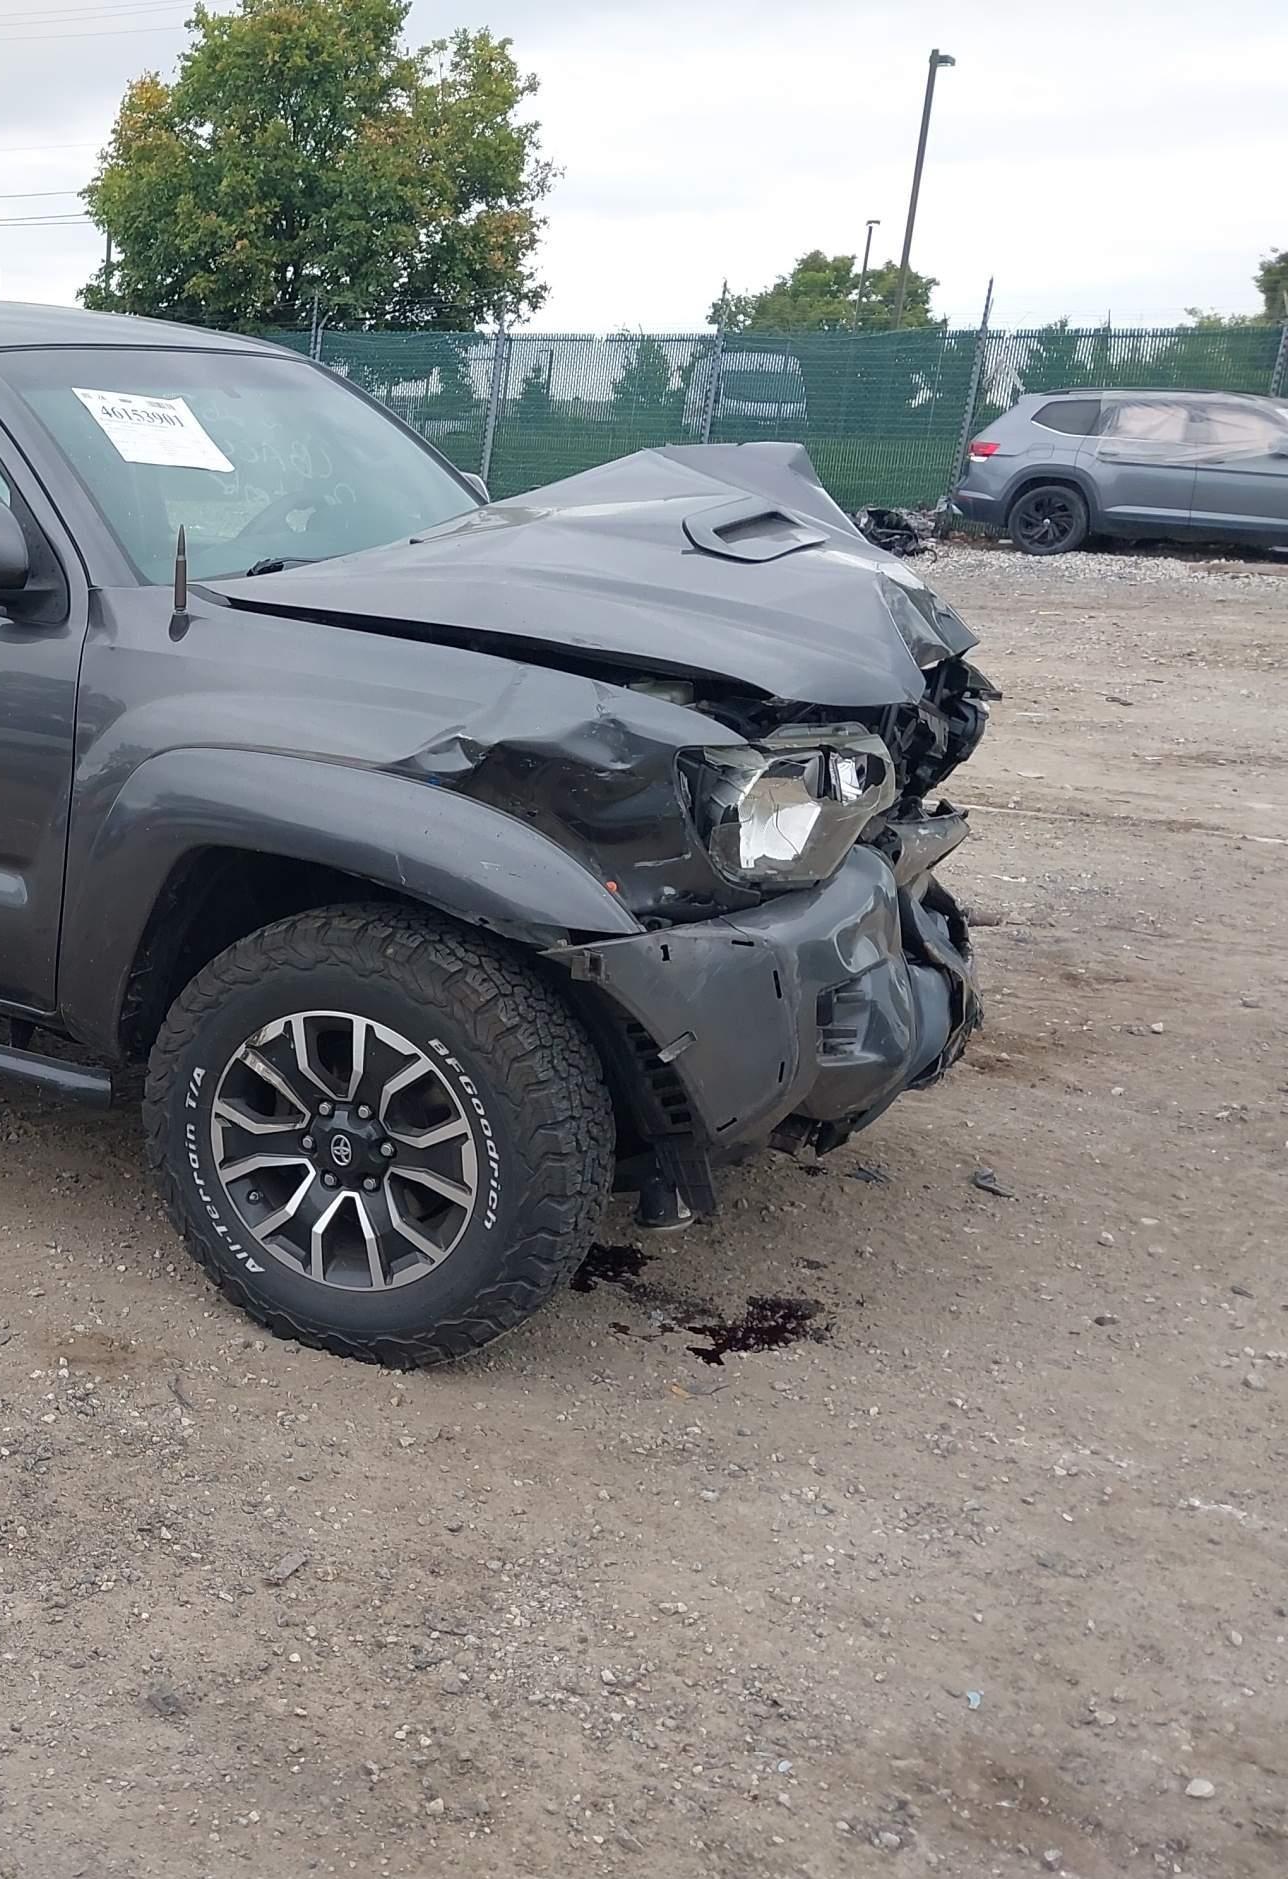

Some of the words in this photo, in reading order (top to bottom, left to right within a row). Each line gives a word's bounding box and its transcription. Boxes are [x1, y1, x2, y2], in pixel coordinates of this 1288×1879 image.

[101, 405, 185, 428] 46153901
[185, 1066, 207, 1109] T/A
[427, 1038, 502, 1230] BFGoodrich
[185, 1122, 266, 1274] All-Terrain
